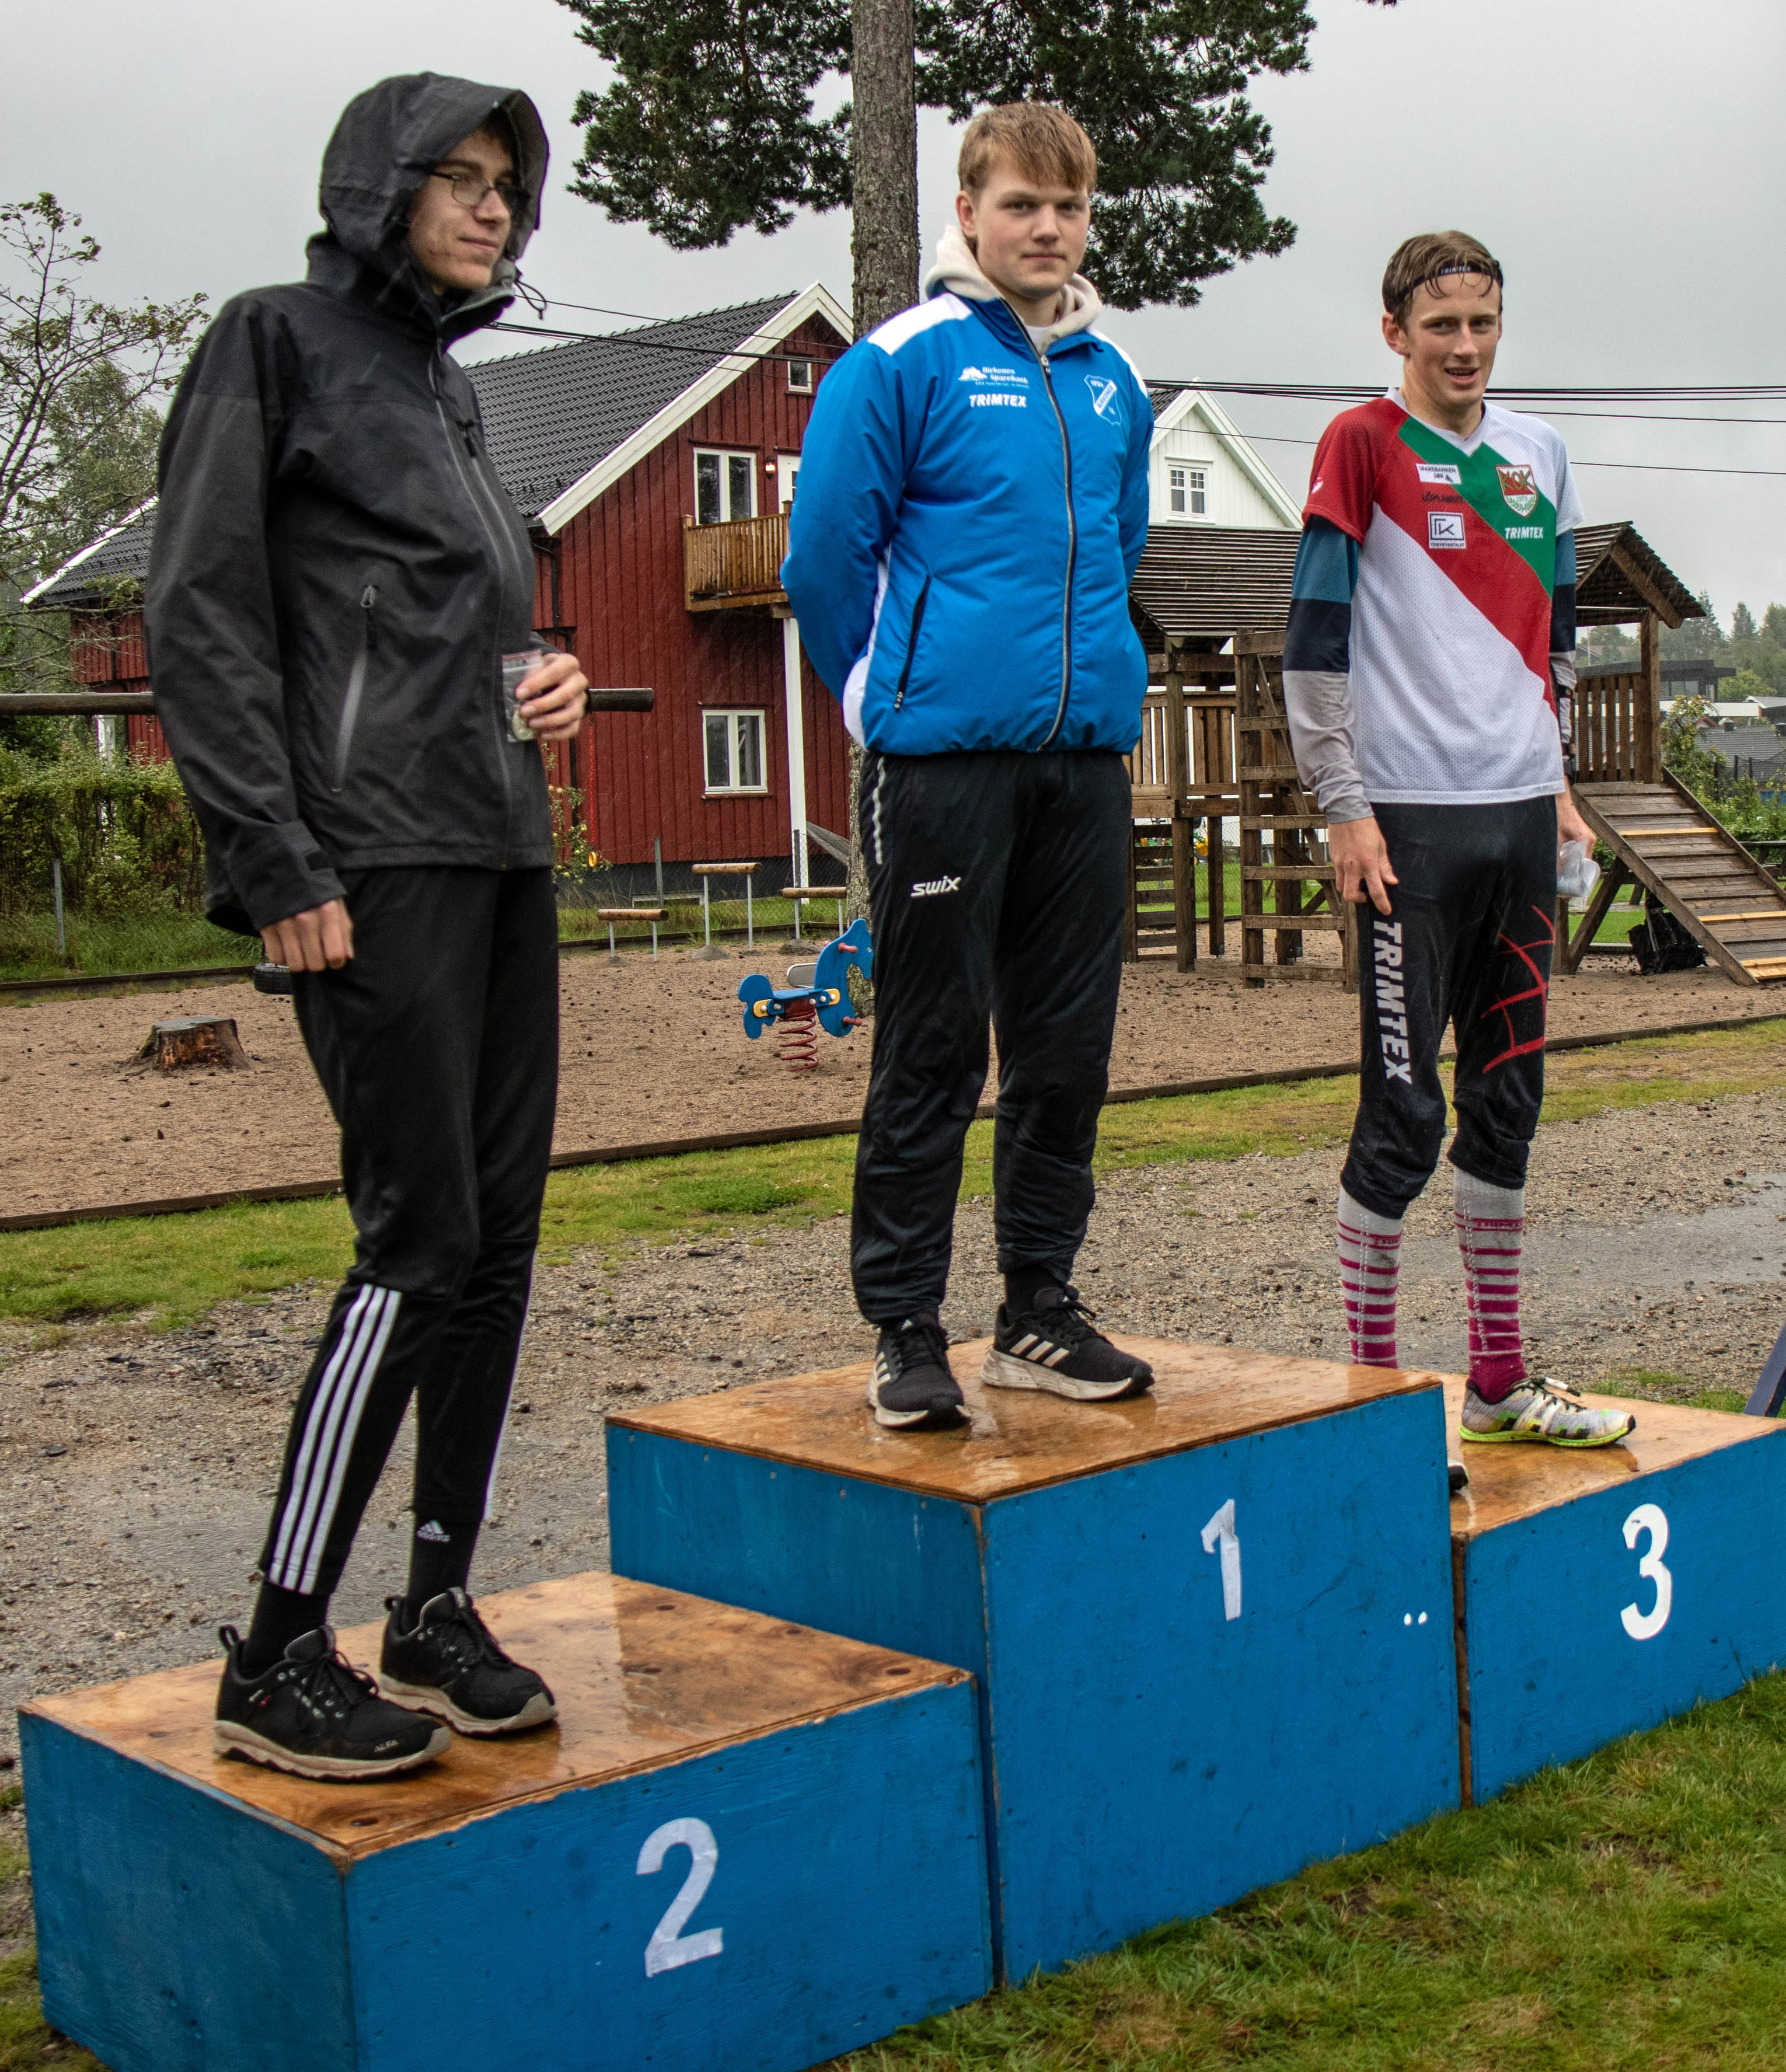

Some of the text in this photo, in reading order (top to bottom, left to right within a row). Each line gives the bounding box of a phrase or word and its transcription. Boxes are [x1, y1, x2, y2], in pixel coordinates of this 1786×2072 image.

[969, 393, 1027, 408] TRIMTEX
[990, 374, 1028, 384] Sparebank
[1505, 526, 1544, 539] TRIMTEX
[1373, 920, 1412, 1084] TRIMTEX
[417, 1530, 451, 1543] adidas
[1201, 1499, 1242, 1621] 1
[1621, 1504, 1673, 1640] 3
[636, 1816, 724, 1979] 2
